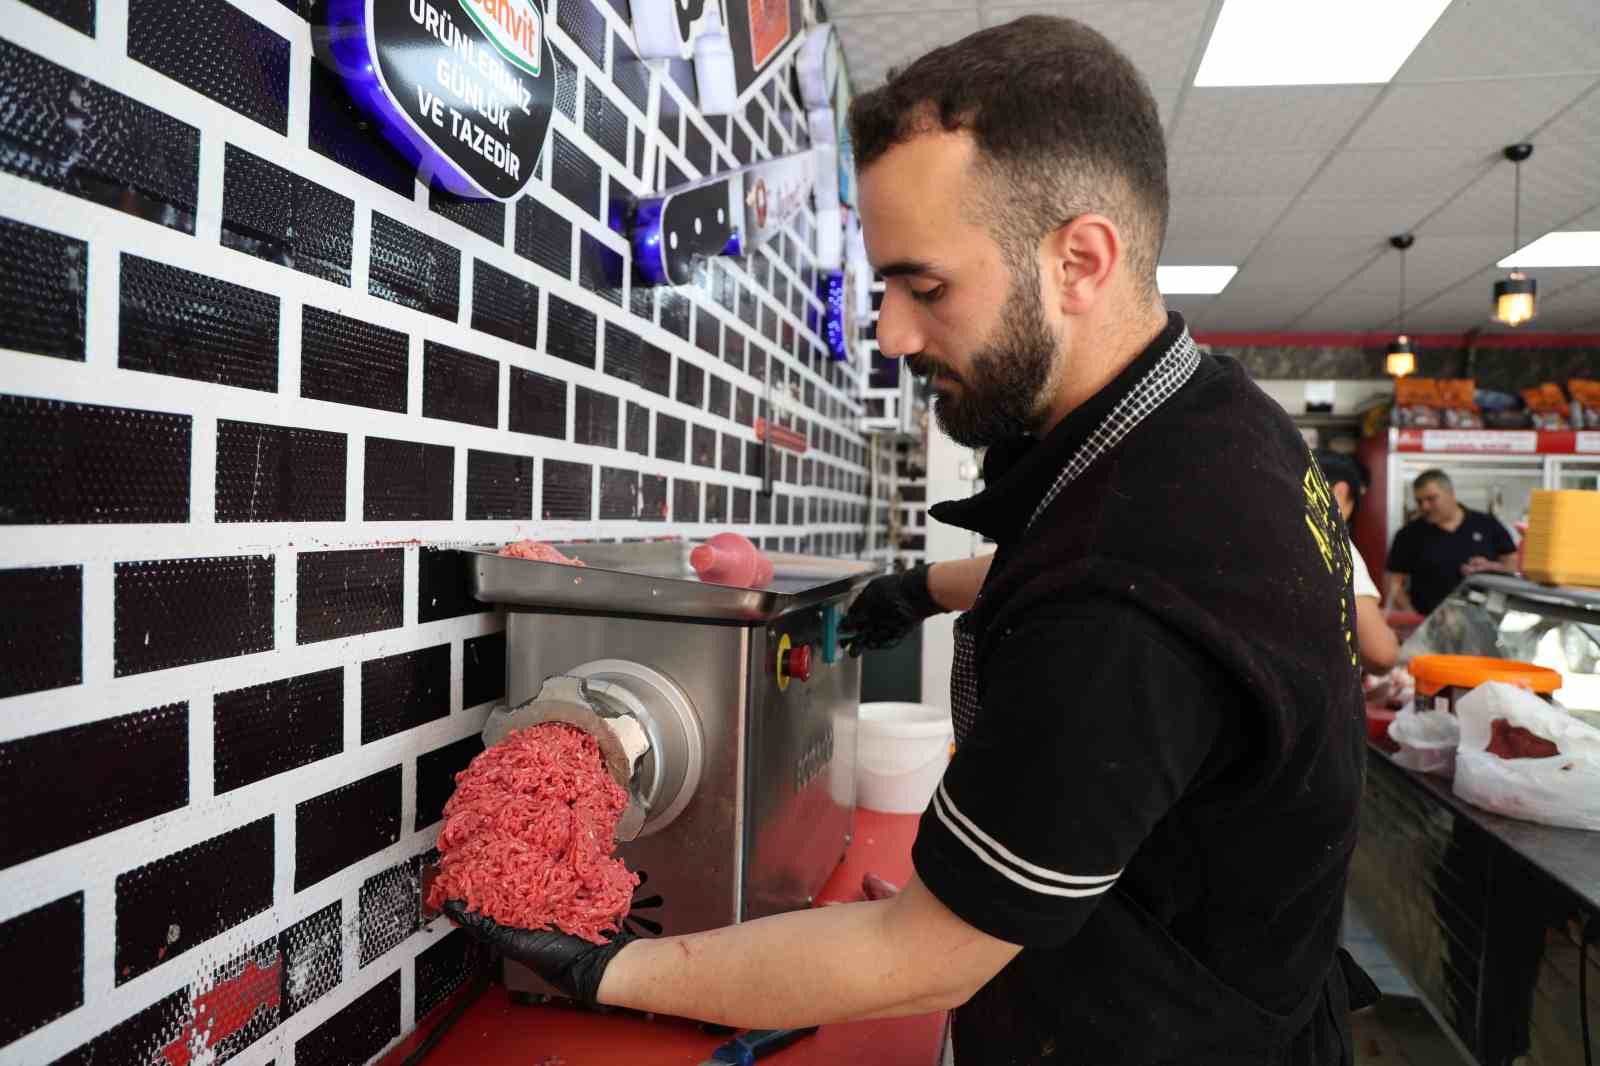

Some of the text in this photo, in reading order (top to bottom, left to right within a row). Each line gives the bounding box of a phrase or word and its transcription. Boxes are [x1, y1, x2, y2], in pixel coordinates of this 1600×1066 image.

[474, 0, 534, 57] anvit
[417, 84, 519, 180] VE TAZEDİR
[437, 58, 510, 135] GÜNLÜK
